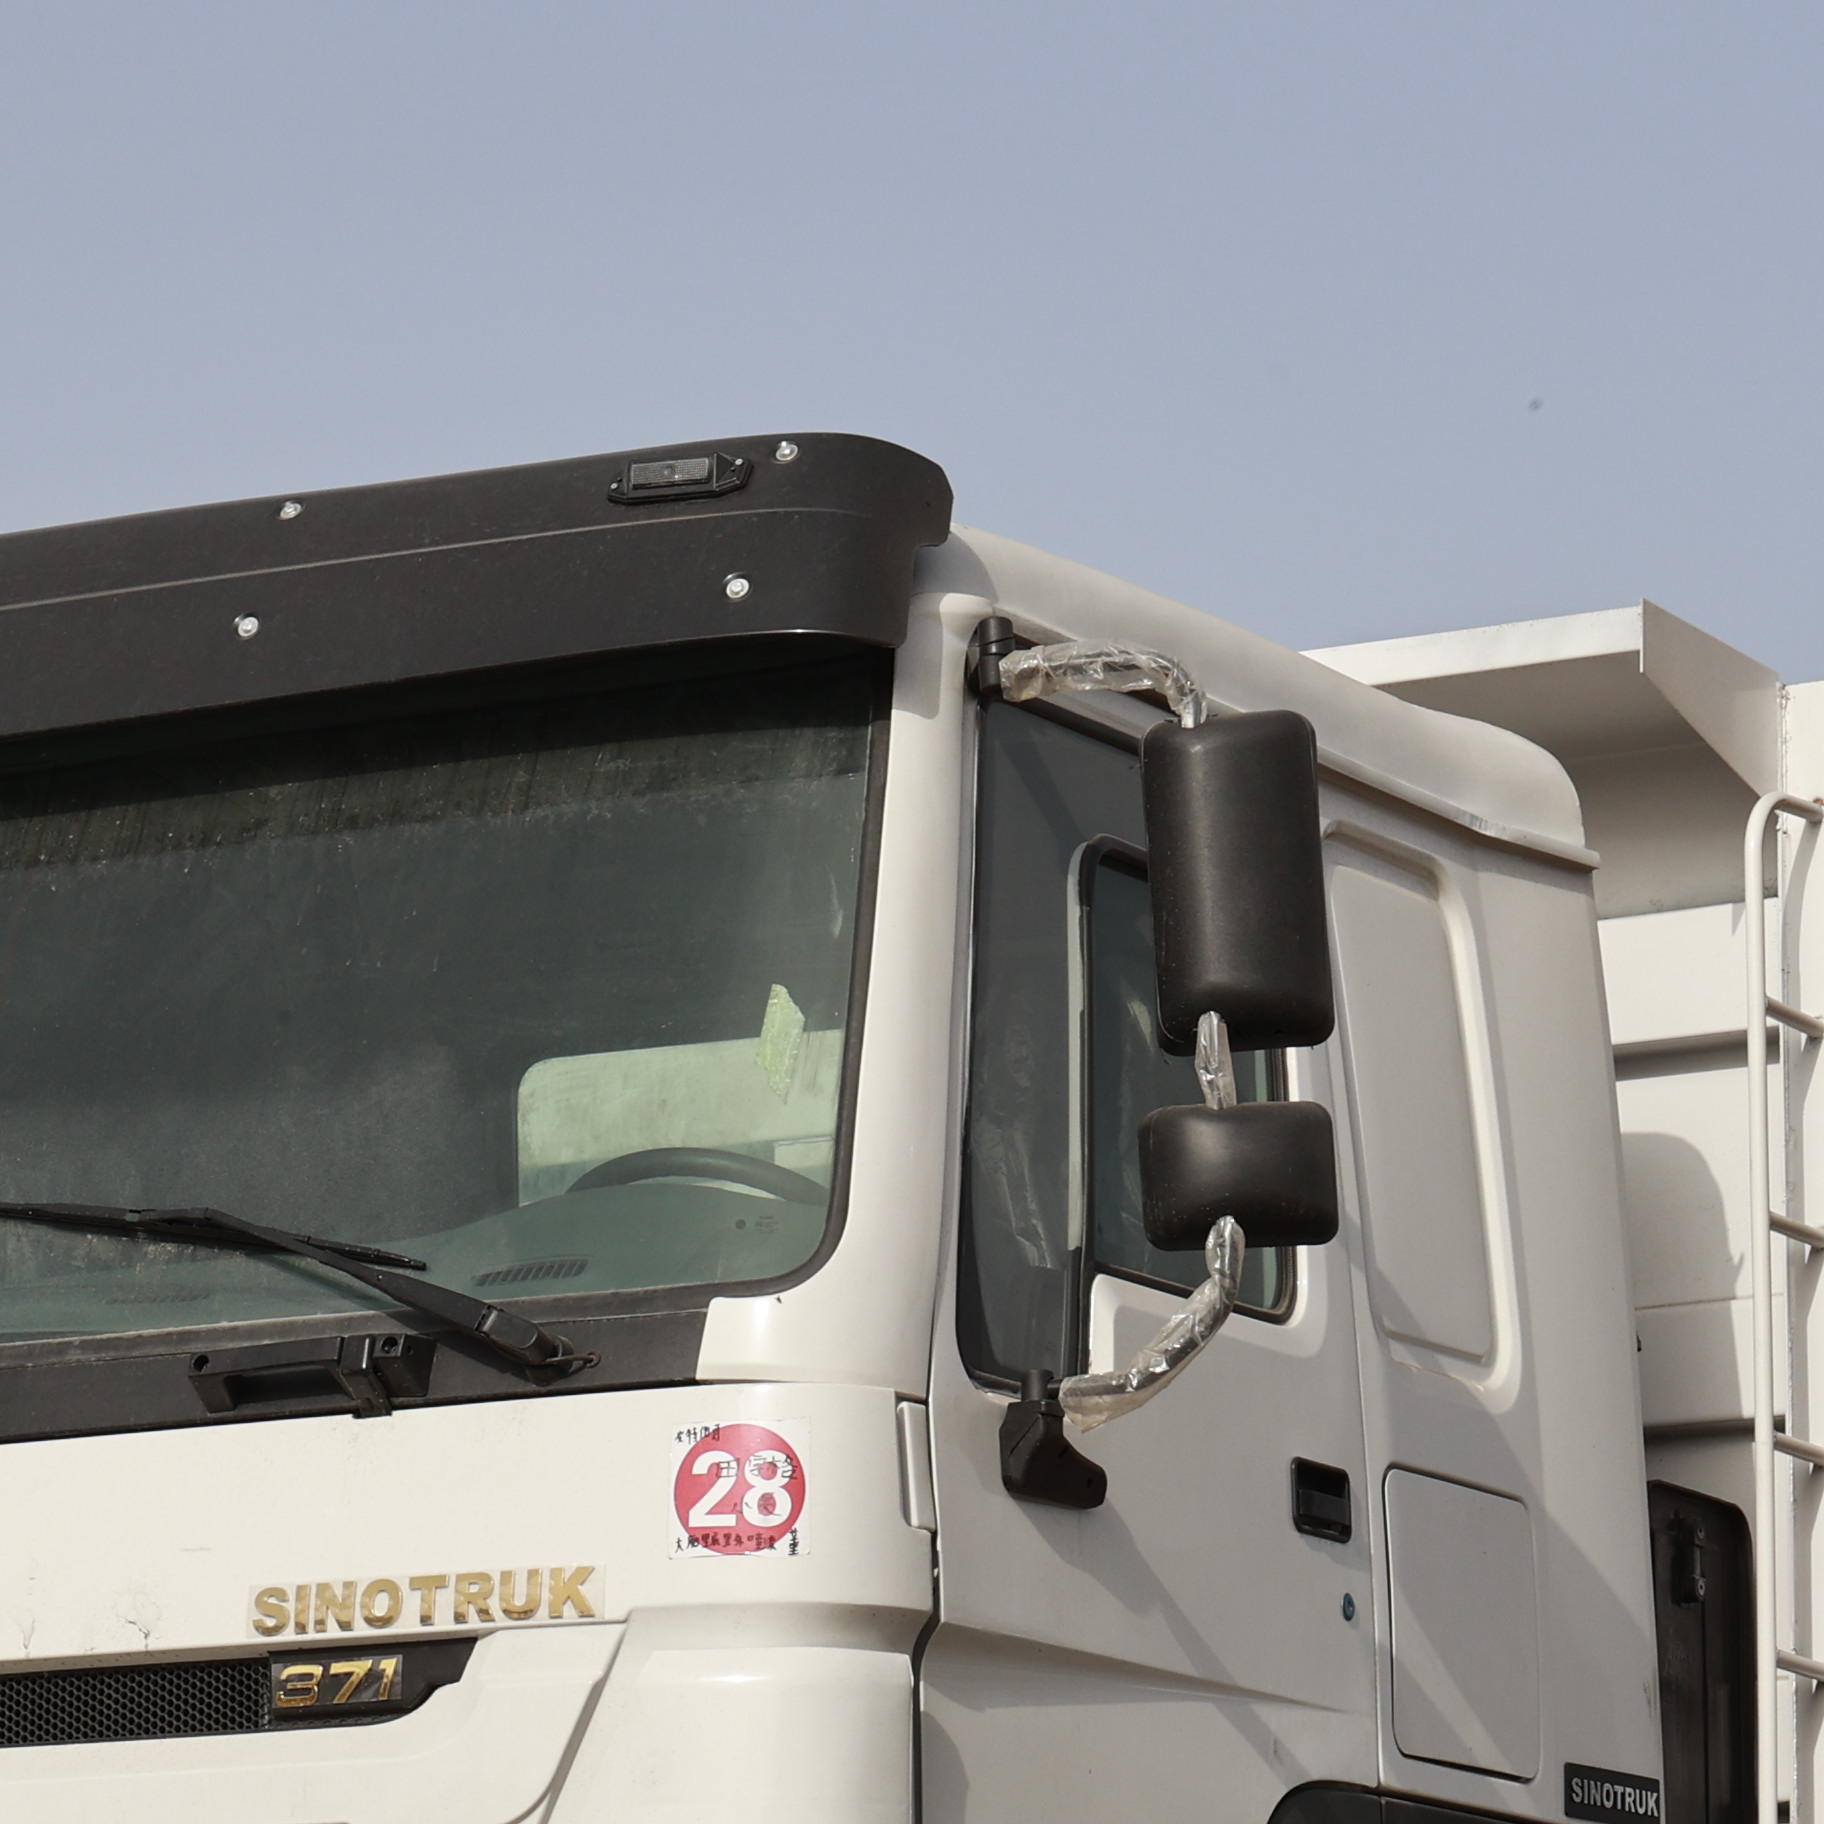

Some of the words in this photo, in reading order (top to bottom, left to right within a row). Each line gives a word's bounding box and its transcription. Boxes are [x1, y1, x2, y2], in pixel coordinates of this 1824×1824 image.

[688, 1449, 793, 1528] 28
[252, 1565, 596, 1637] SINOTRUK
[275, 1657, 400, 1708] 371
[1570, 1776, 1659, 1818] SINOTRUK
